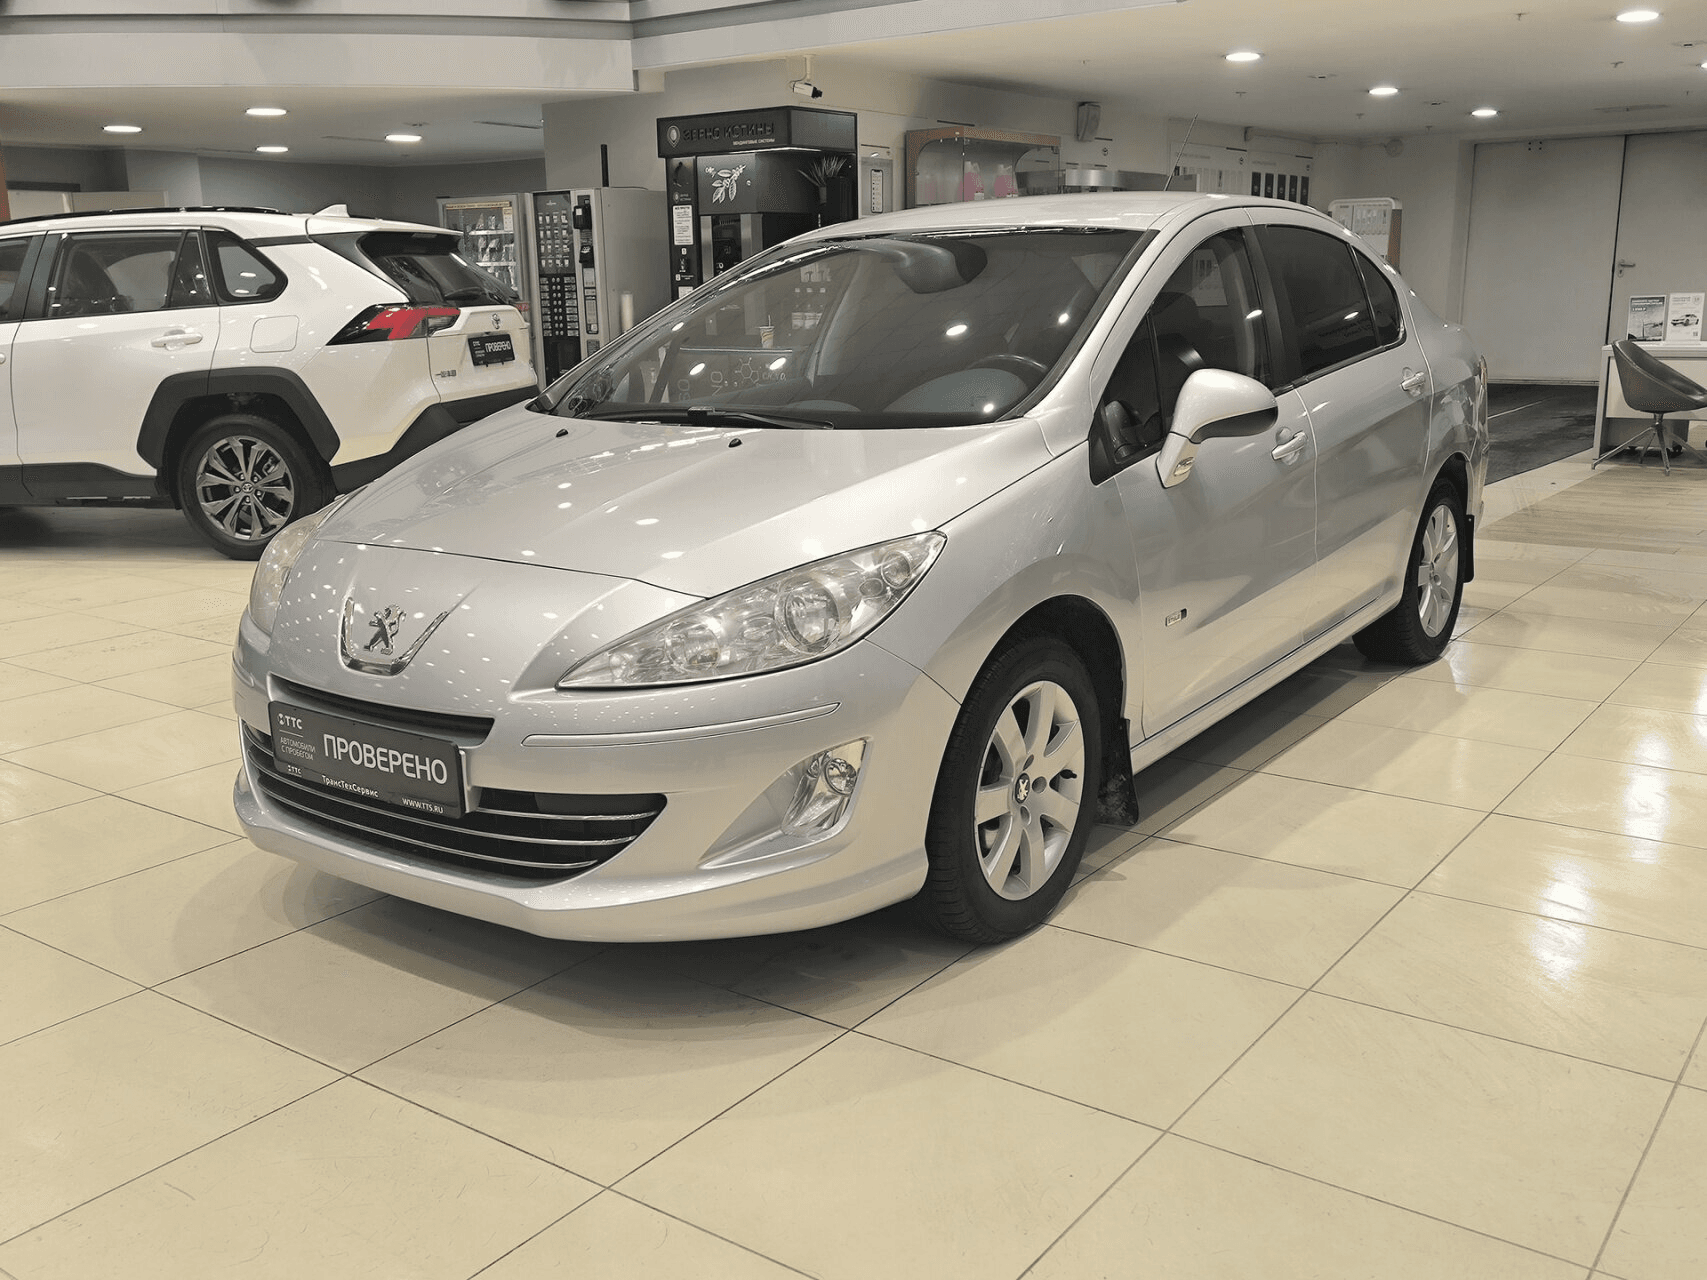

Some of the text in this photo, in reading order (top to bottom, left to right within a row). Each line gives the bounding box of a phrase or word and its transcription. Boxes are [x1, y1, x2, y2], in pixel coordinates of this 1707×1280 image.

[724, 122, 775, 139] ИСТИНЫ
[485, 340, 512, 353] ПРОВЕРЕНО
[280, 736, 316, 753] АВТОМОБИЛИ
[285, 746, 314, 760] ПРОБЕГОМ
[323, 733, 448, 785] ПРОВЕРЕНО
[321, 774, 379, 798] ТрансТехСервис
[402, 797, 444, 814] WWW.TTS.RU
